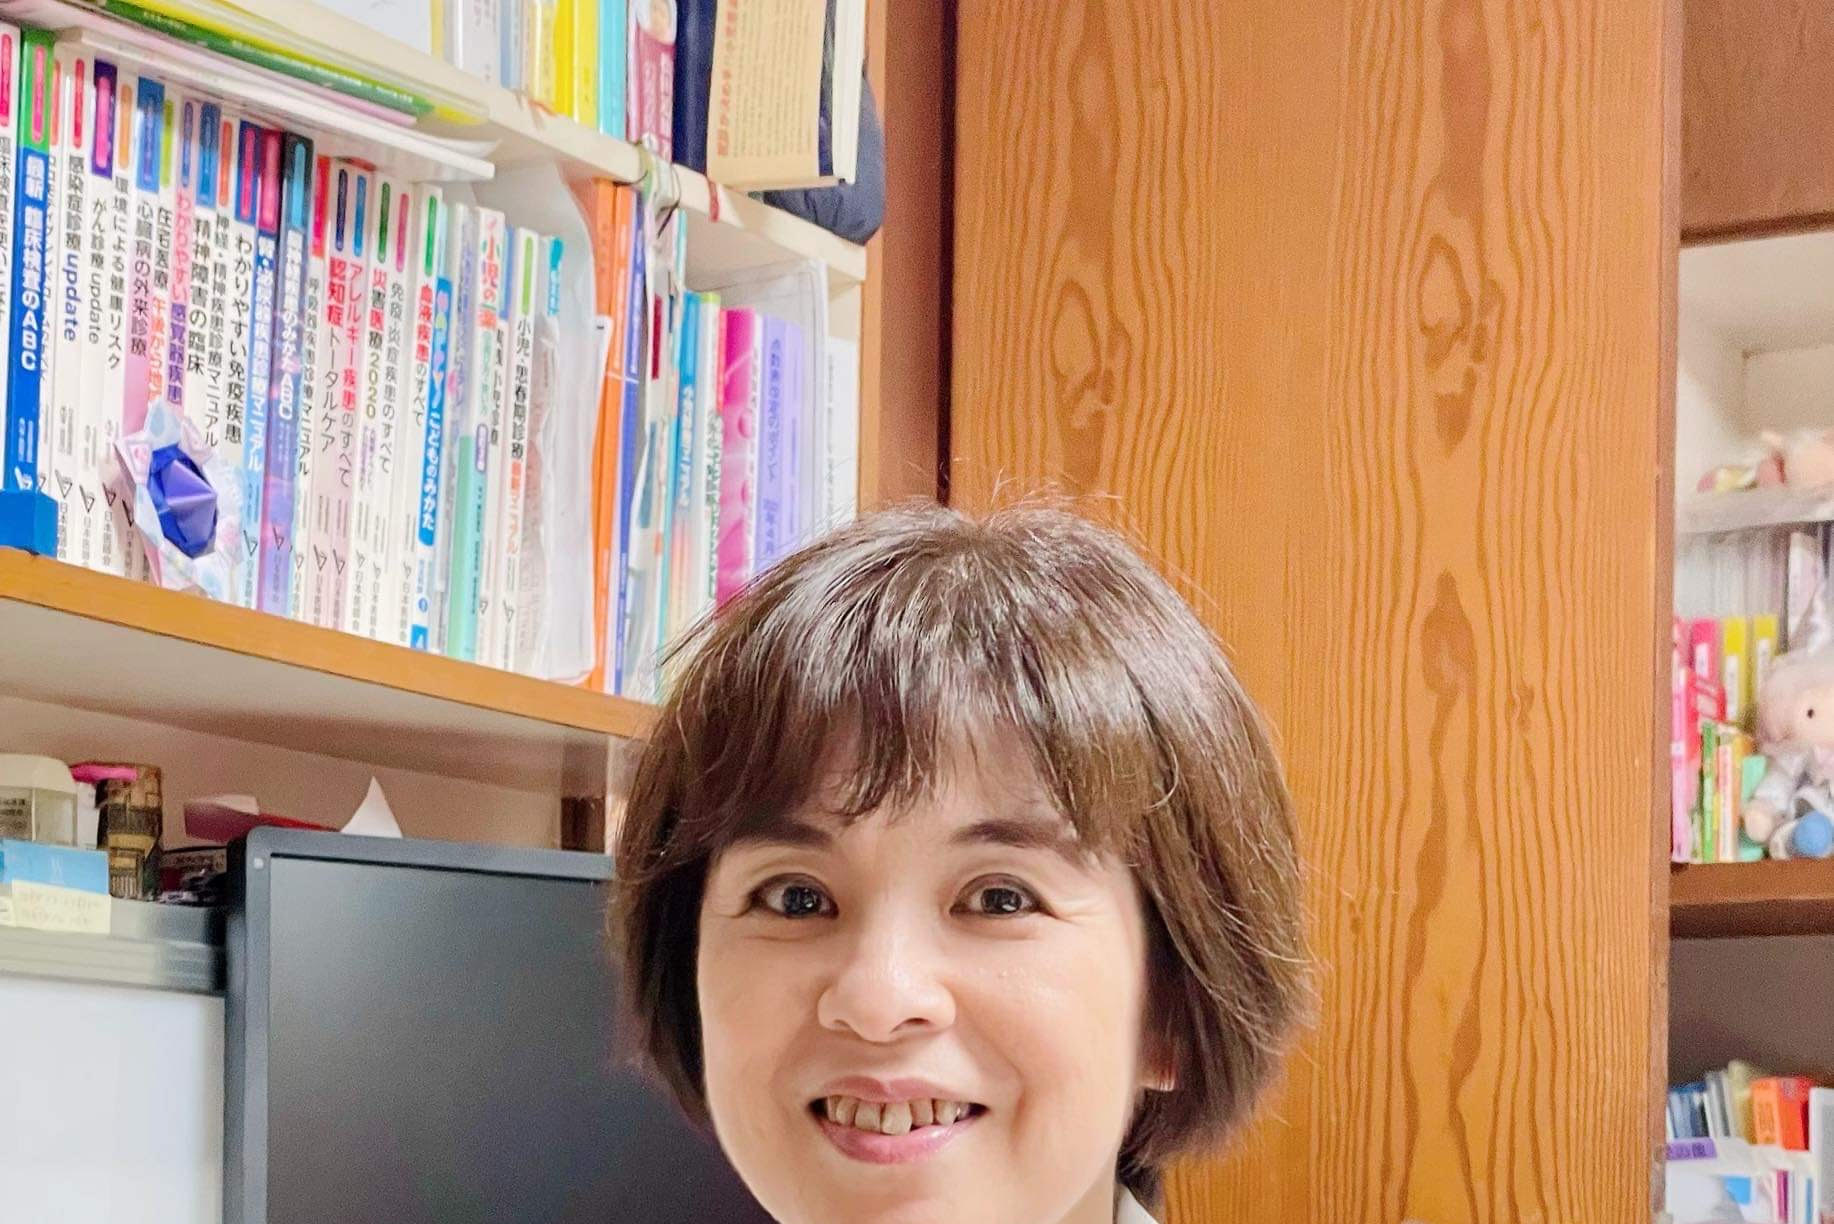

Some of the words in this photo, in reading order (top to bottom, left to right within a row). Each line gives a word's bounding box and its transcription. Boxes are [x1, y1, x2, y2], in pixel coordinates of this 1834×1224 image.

[131, 201, 153, 357] 心臓病の外来診療
[187, 218, 210, 375] 精神障害の臨床
[225, 233, 252, 444] わかりやすい免疫疾患
[321, 256, 347, 452] 認知症トータルケア
[411, 283, 433, 427] 血液疾患のすべて
[338, 263, 363, 487] アレルギー疾患のすべて
